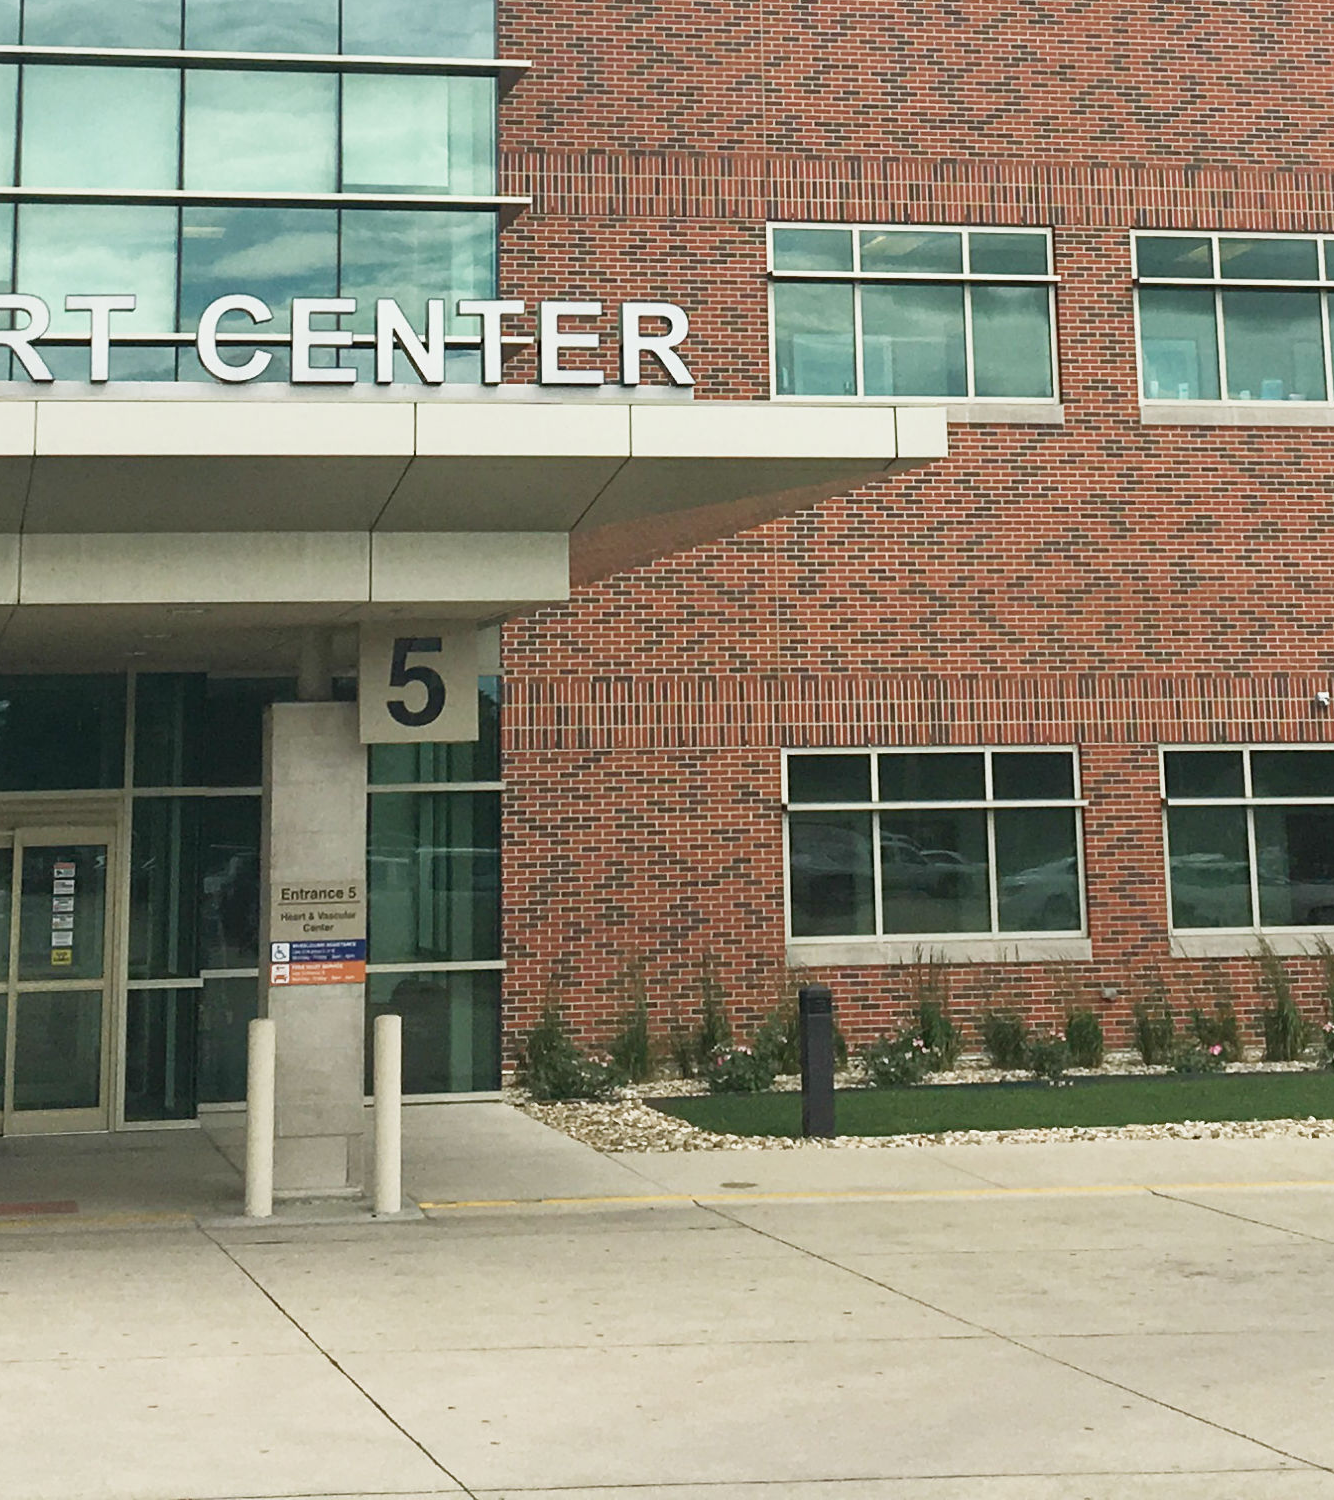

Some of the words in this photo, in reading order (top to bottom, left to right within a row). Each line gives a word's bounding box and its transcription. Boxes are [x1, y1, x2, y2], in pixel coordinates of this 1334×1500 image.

[194, 293, 696, 388] CENTER
[386, 636, 447, 727] 5
[280, 886, 345, 901] Entrance
[348, 886, 357, 899] 5
[280, 912, 306, 922] Heart
[308, 912, 315, 921] &
[318, 910, 357, 921] Vascular
[302, 923, 335, 933] Center
